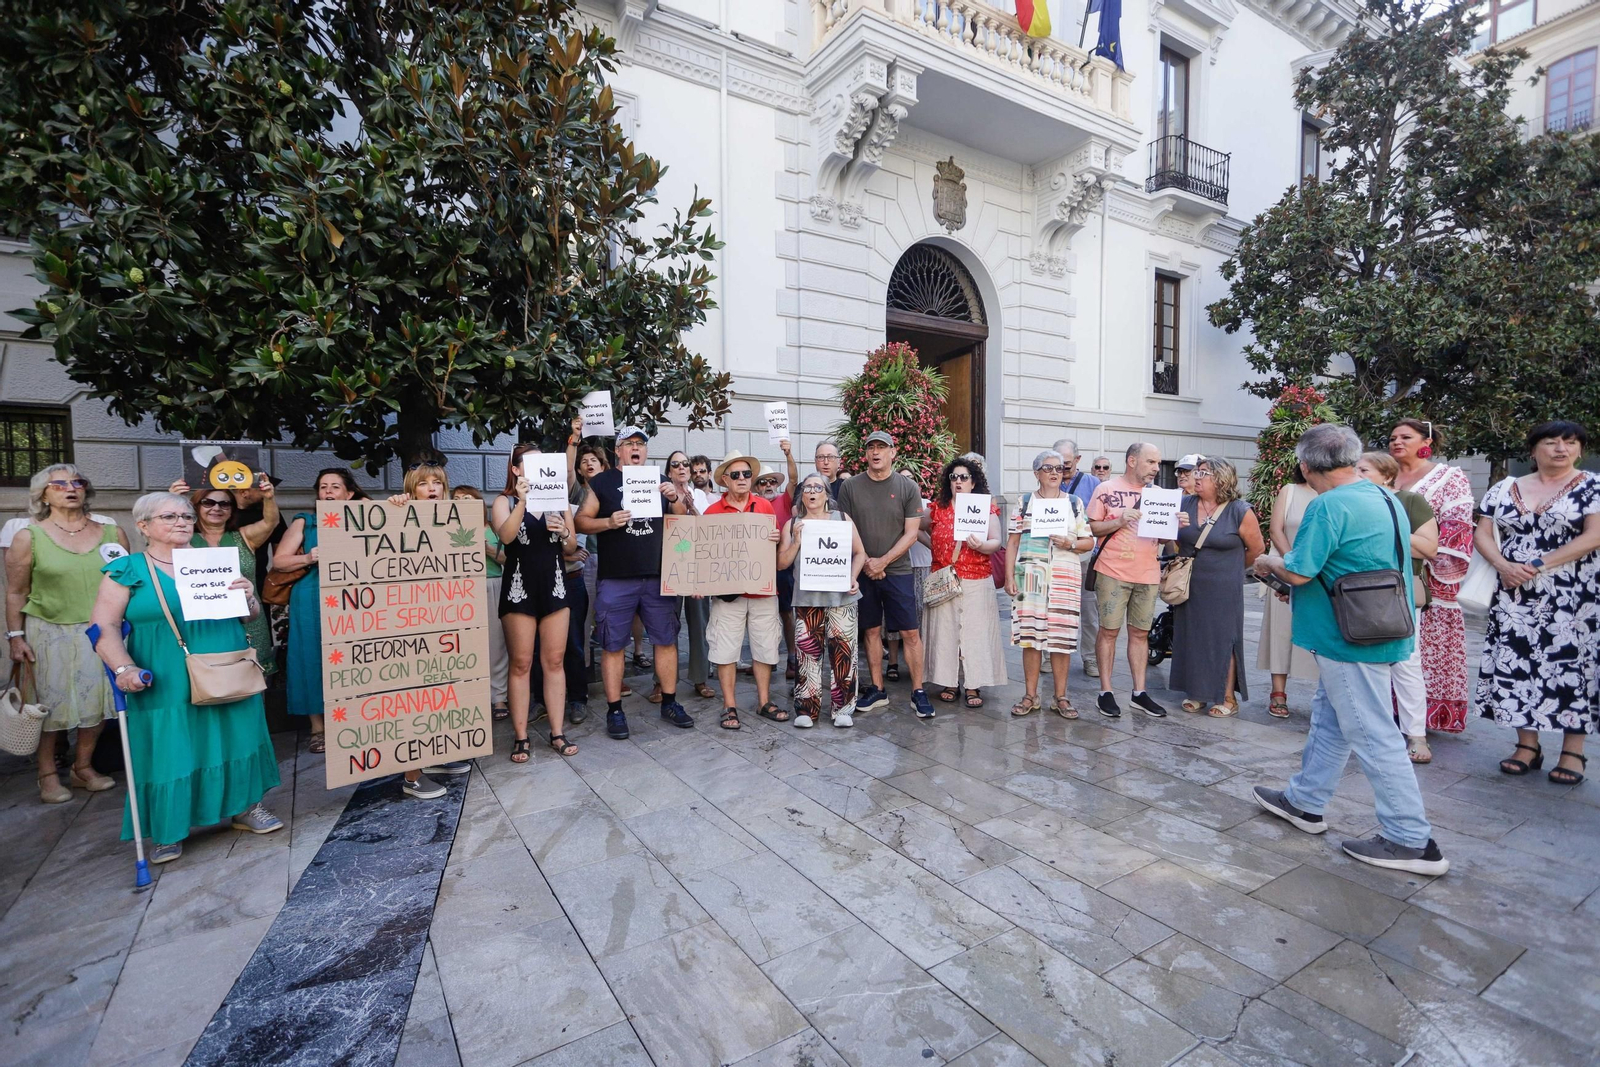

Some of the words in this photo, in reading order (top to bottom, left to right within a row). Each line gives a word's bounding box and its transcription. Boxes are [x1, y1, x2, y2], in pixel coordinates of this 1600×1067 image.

[539, 467, 557, 478] No
[529, 482, 564, 490] TALARÁN
[967, 505, 981, 514] No
[1044, 507, 1059, 515] No
[1144, 499, 1176, 508] Cervantes
[343, 504, 387, 532] NO
[404, 504, 421, 528] A
[432, 503, 462, 527] LA
[1146, 518, 1168, 526] árboles
[668, 524, 769, 542] AYUNTAMIENTO
[352, 529, 433, 557] TALA
[694, 541, 750, 560] ESCUCHA
[818, 536, 838, 550] No
[328, 560, 360, 582] EN
[371, 551, 485, 580] CERVANTES
[805, 555, 847, 565] TALARÁN
[180, 566, 233, 576] Cervantes
[667, 562, 680, 584] A
[687, 562, 706, 584] EL
[709, 560, 762, 583] BARRIO
[193, 592, 228, 600] árboles
[341, 586, 376, 611] NO
[386, 579, 475, 607] ELIMINAR
[327, 614, 356, 636] VIA
[361, 609, 387, 633] DE
[395, 603, 475, 629] SERVICIO
[352, 637, 430, 665] REFORMA
[438, 633, 460, 654] SI
[329, 666, 372, 689] PERO
[379, 661, 410, 681] CON
[417, 653, 478, 676] DIÁLOGO
[423, 671, 461, 684] REAL
[360, 684, 459, 721] GRANADA
[337, 719, 405, 749] QUIERE
[412, 706, 485, 736] SOMBRA
[349, 747, 382, 775] NO
[394, 728, 486, 764] CEMENTO
